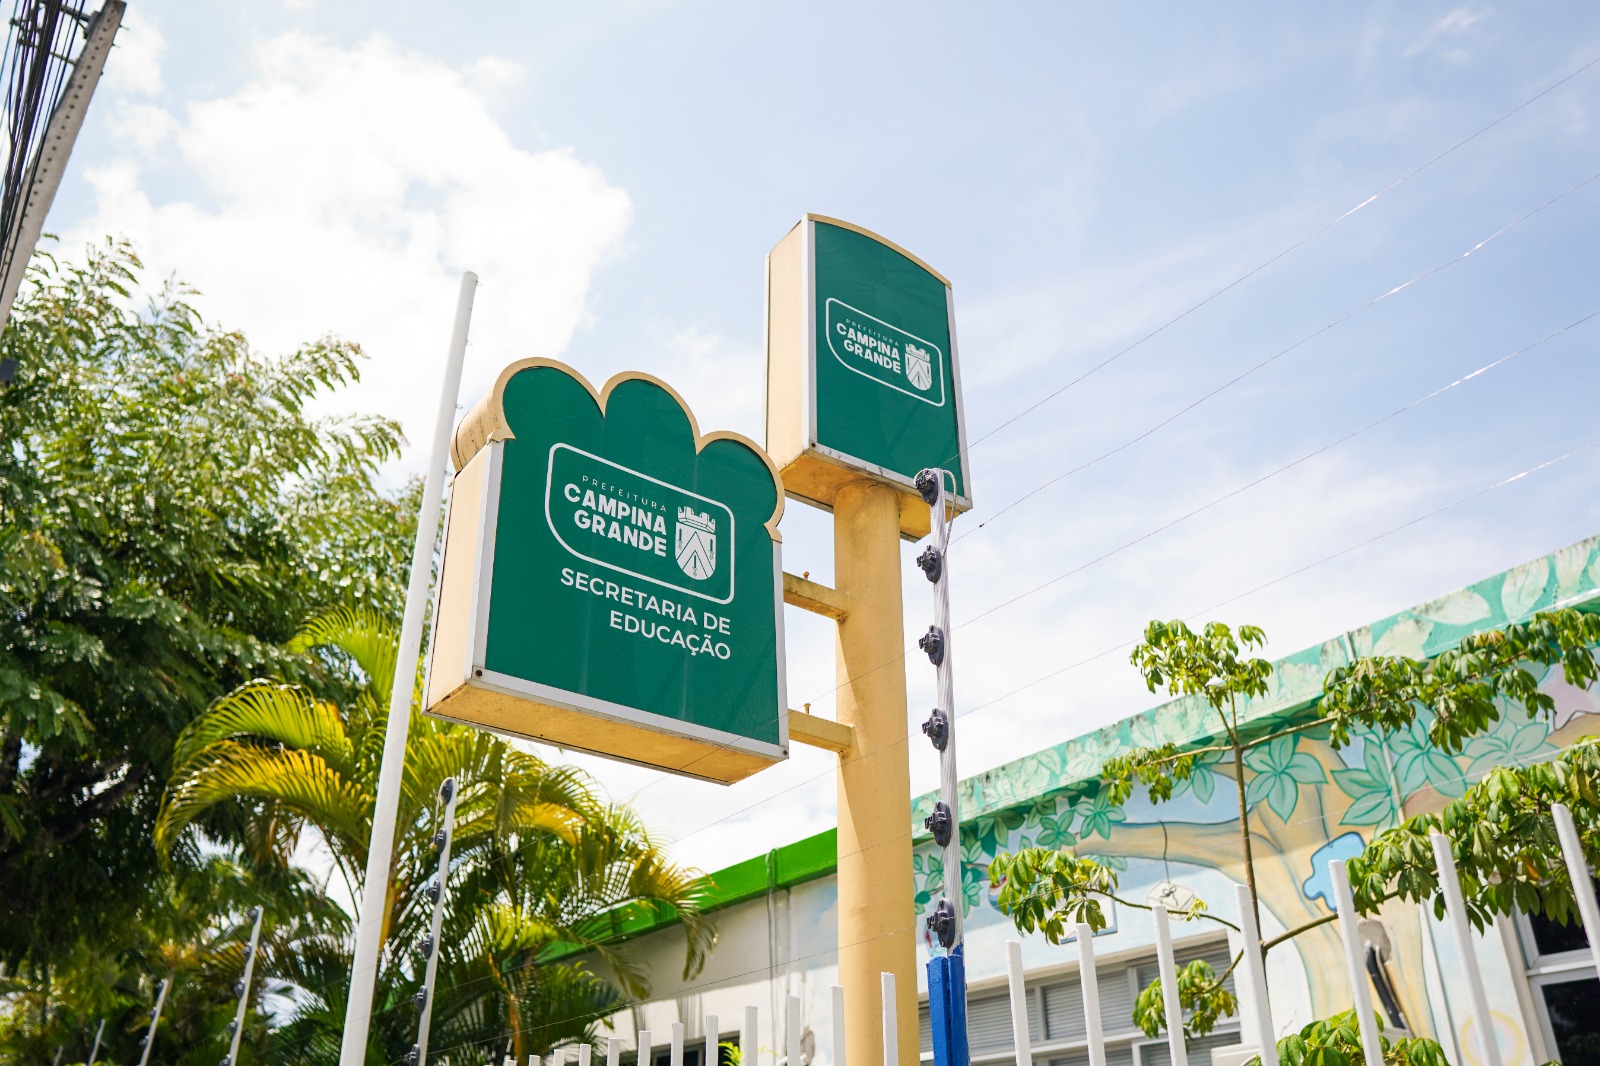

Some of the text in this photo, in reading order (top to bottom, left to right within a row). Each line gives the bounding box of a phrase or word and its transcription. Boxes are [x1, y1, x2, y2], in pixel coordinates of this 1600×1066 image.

[836, 322, 900, 360] CAMPINA
[846, 318, 899, 346] PREFEITURA
[843, 339, 901, 374] GRANDE
[564, 483, 667, 535] CAMPINA
[582, 475, 667, 512] PREFEITURA
[574, 509, 667, 557] GRANDE
[560, 567, 731, 635] SECRETARIA DE
[609, 610, 731, 660] EDUCAÇÃO
